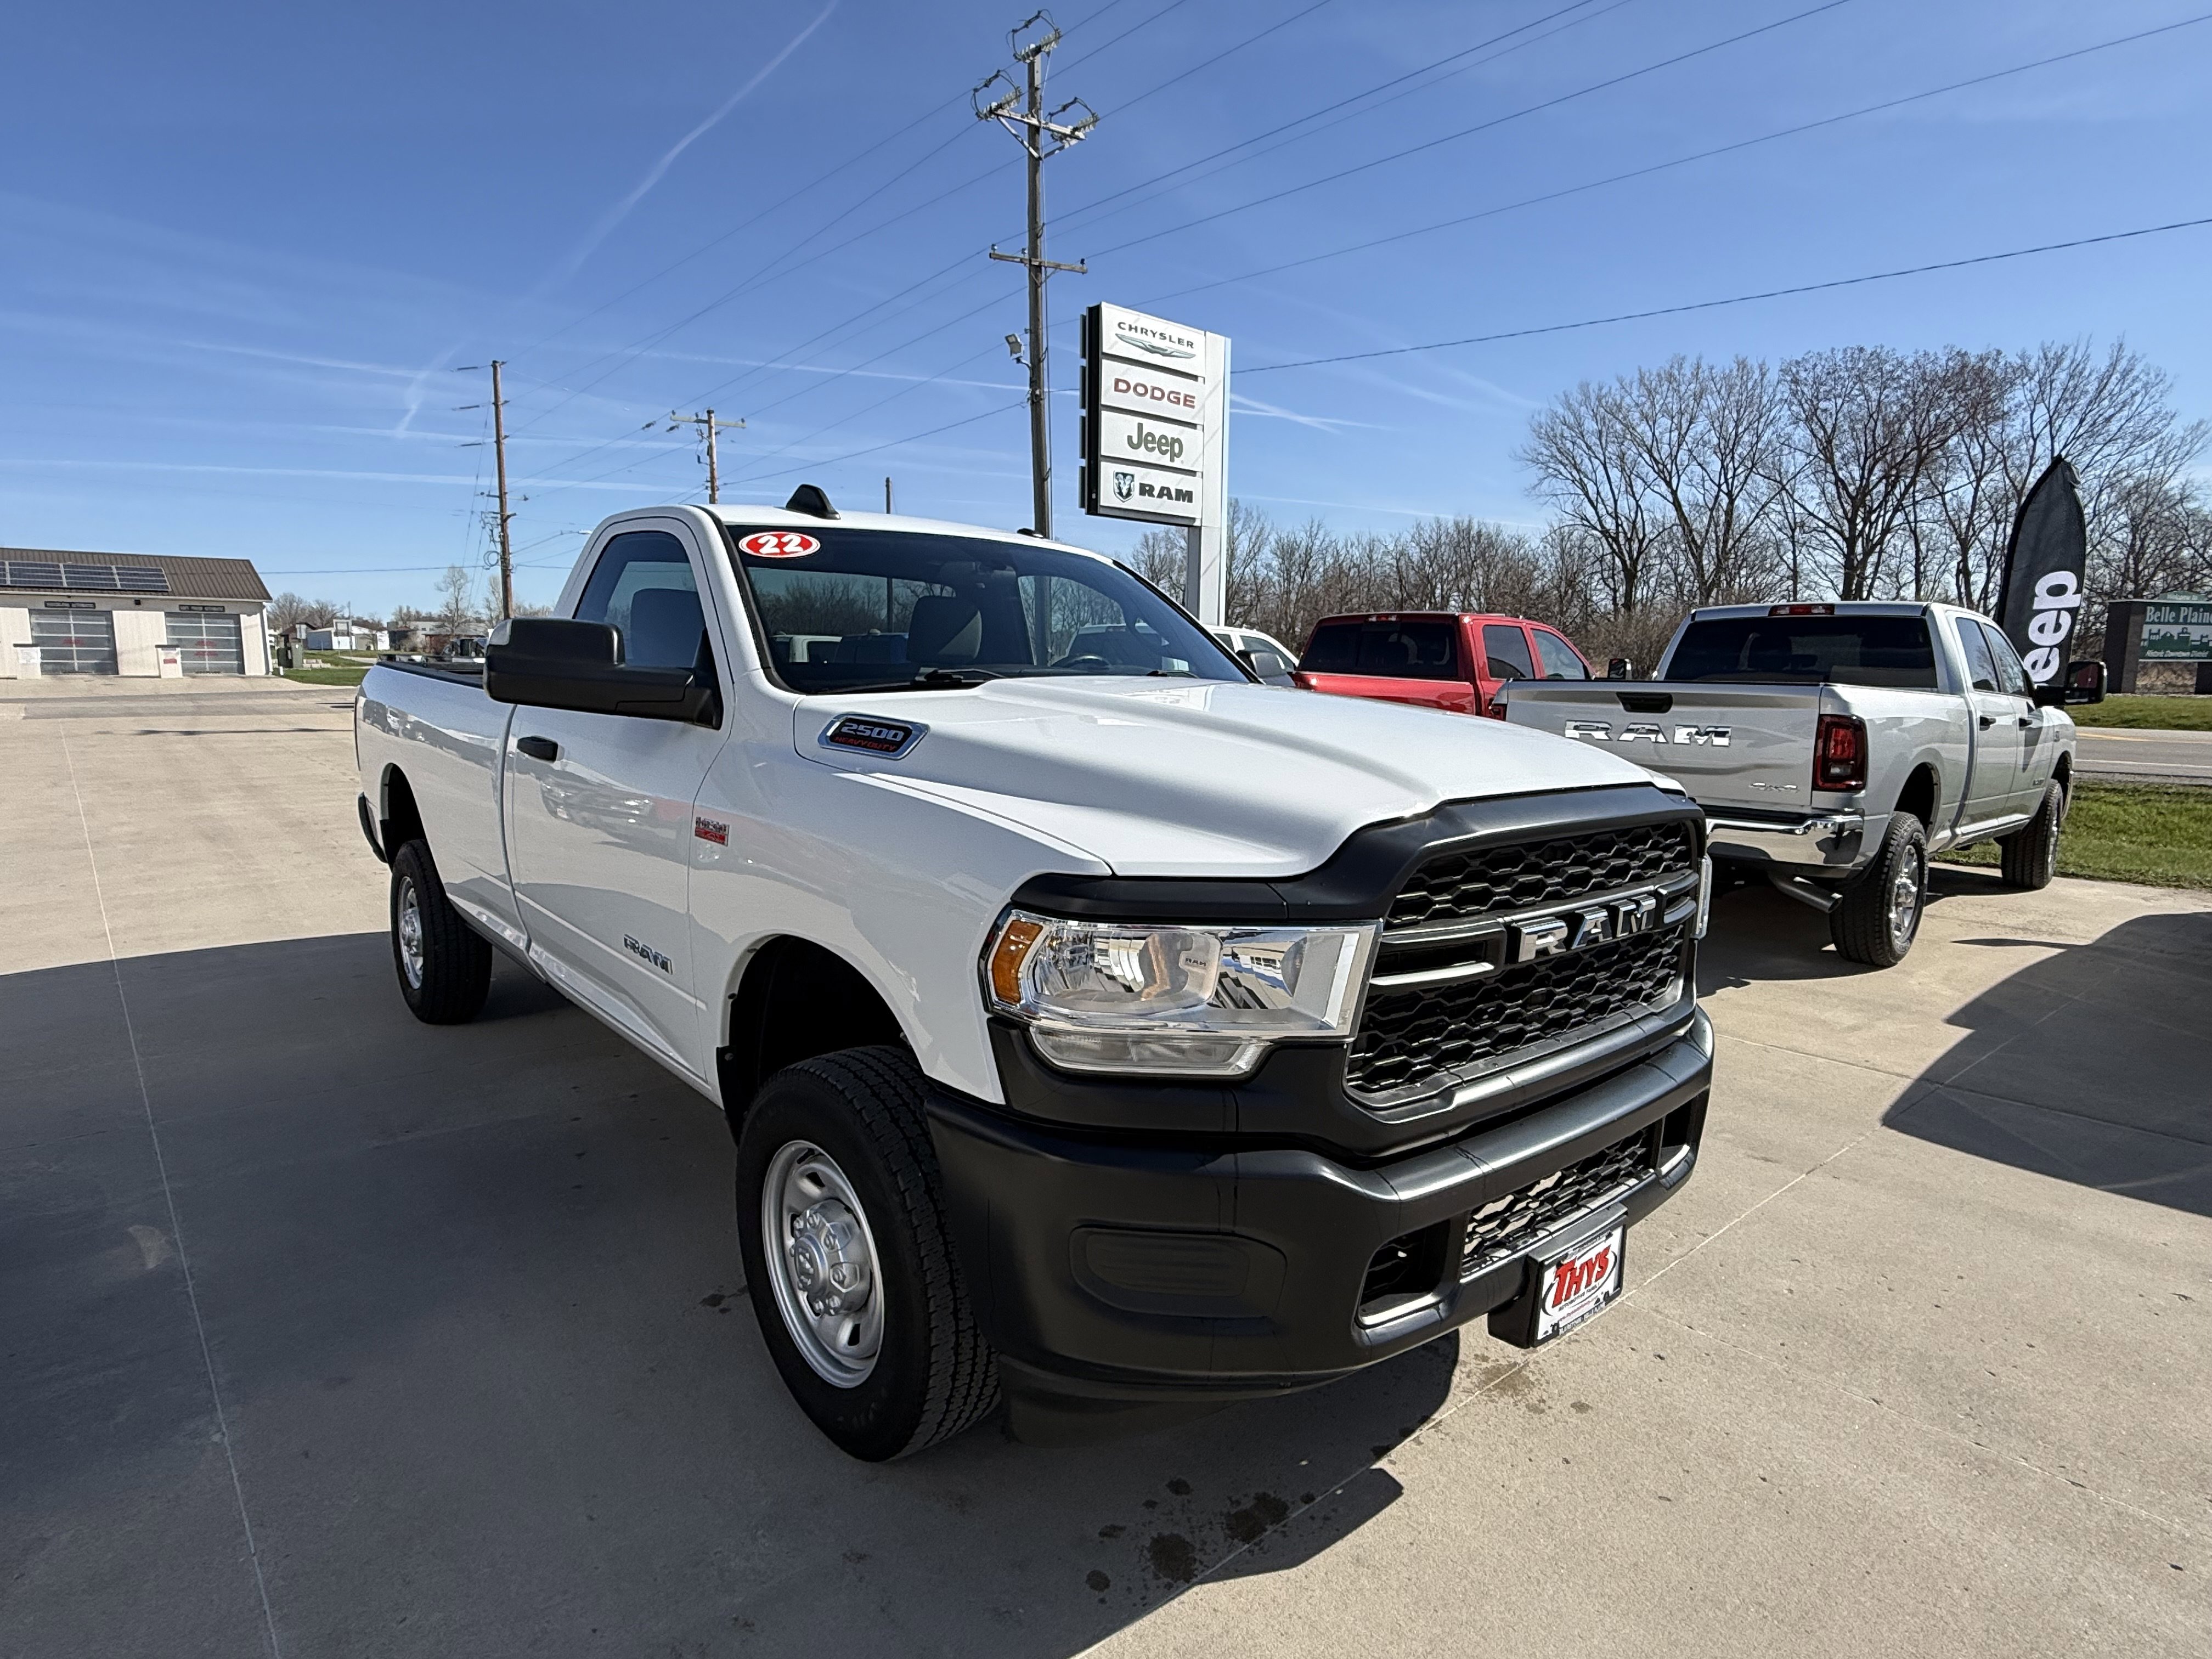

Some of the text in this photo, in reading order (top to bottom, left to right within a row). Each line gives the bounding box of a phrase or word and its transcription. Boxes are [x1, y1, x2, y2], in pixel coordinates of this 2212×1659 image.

[1117, 321, 1194, 349] CHRYSLER
[1114, 377, 1196, 409] DODGE
[1127, 422, 1184, 462] Jeep
[1139, 482, 1193, 504] RAM
[757, 534, 804, 554] 22
[2023, 571, 2081, 685] eep
[2145, 606, 2176, 623] Belle
[834, 736, 898, 751] HEAVY DUTY
[840, 723, 904, 742] 2500
[1565, 719, 1733, 747] RAM
[1513, 894, 1656, 963] RAM
[623, 934, 673, 975] RAM
